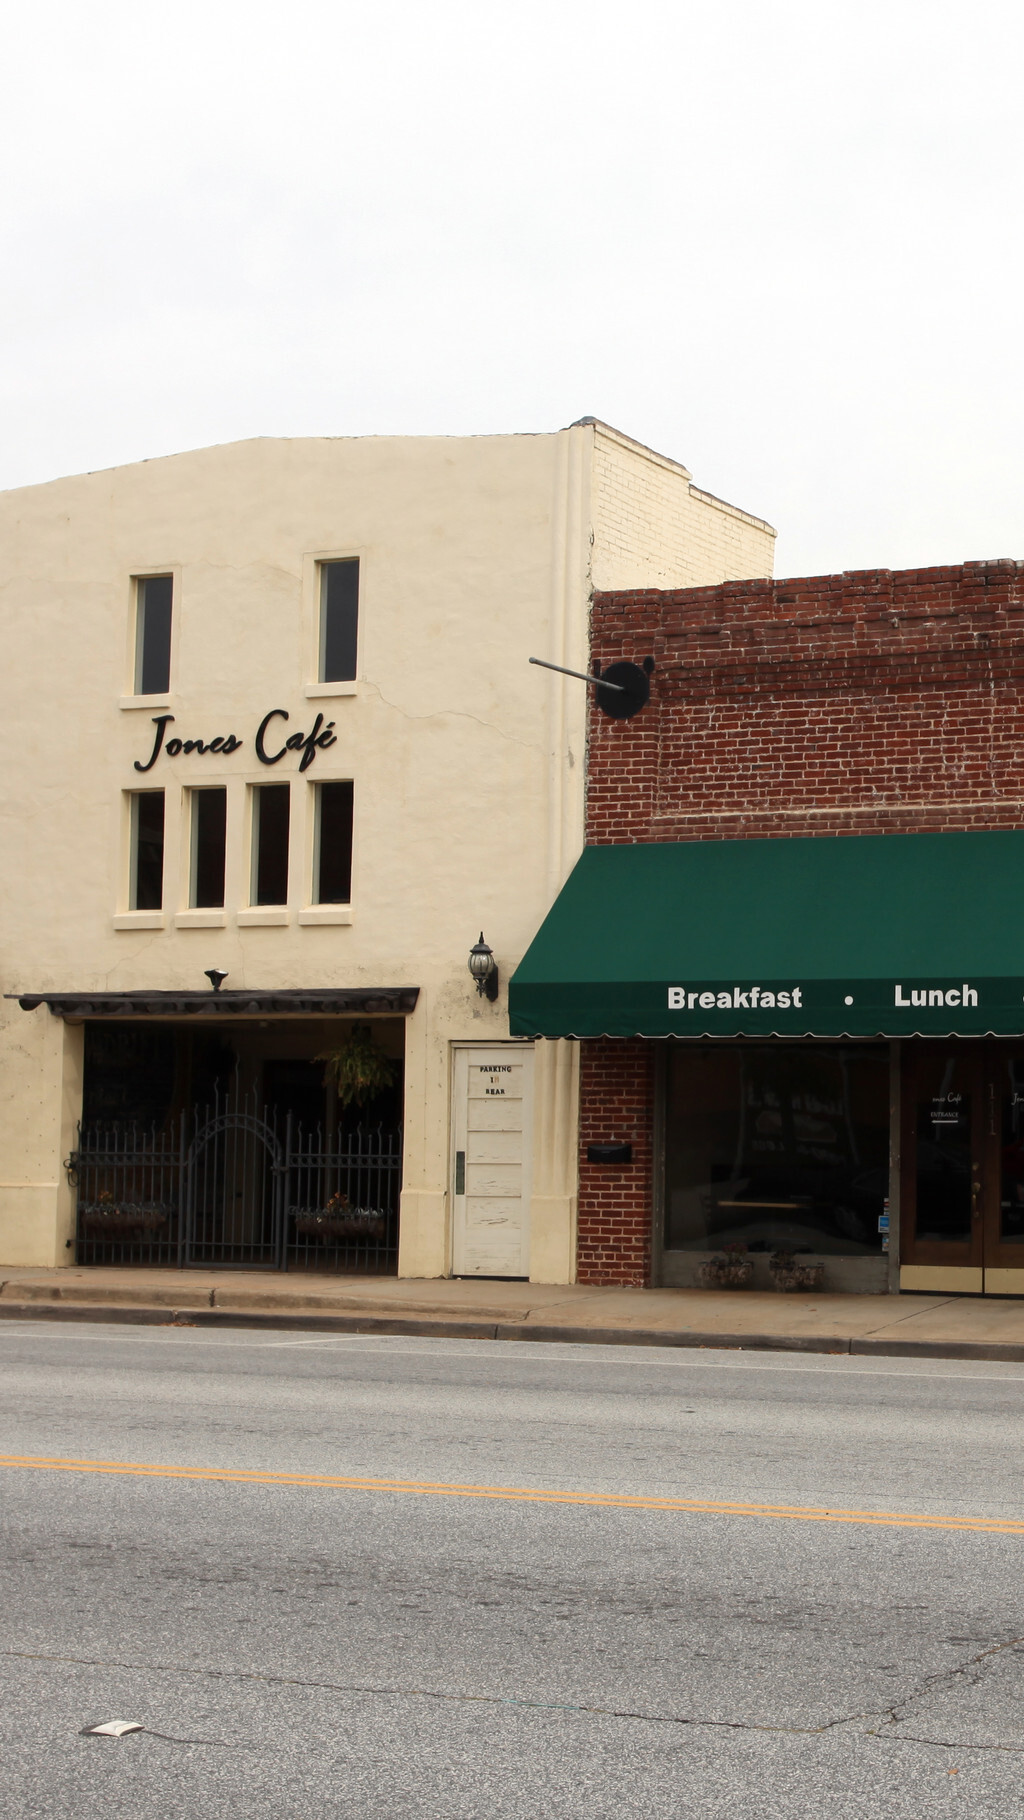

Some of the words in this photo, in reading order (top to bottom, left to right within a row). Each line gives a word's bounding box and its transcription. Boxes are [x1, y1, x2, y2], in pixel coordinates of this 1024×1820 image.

[134, 714, 243, 772] Jones
[255, 709, 338, 772] Café
[667, 986, 803, 1010] Breakfast
[894, 984, 978, 1007] Lunch
